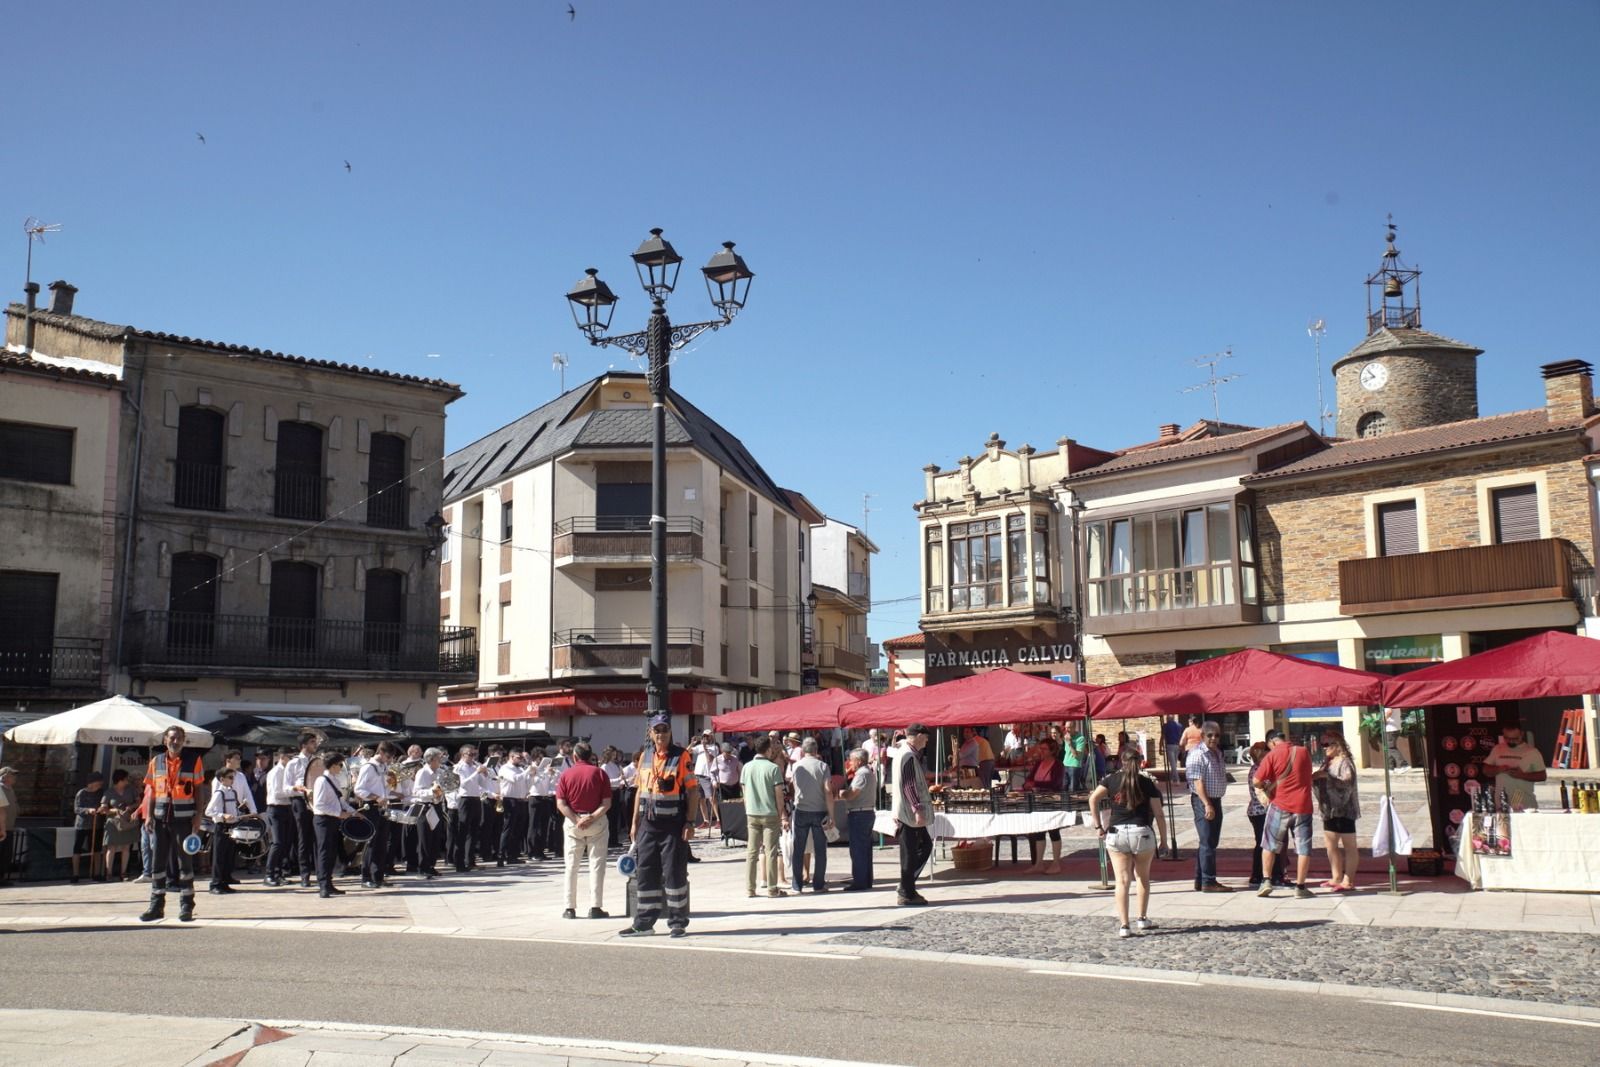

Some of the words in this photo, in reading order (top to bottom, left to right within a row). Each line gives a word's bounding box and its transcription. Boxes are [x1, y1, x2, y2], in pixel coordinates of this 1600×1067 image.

[928, 649, 1009, 668] FARMACIA
[1018, 644, 1073, 663] CALVO
[108, 736, 135, 744] AMSTEL
